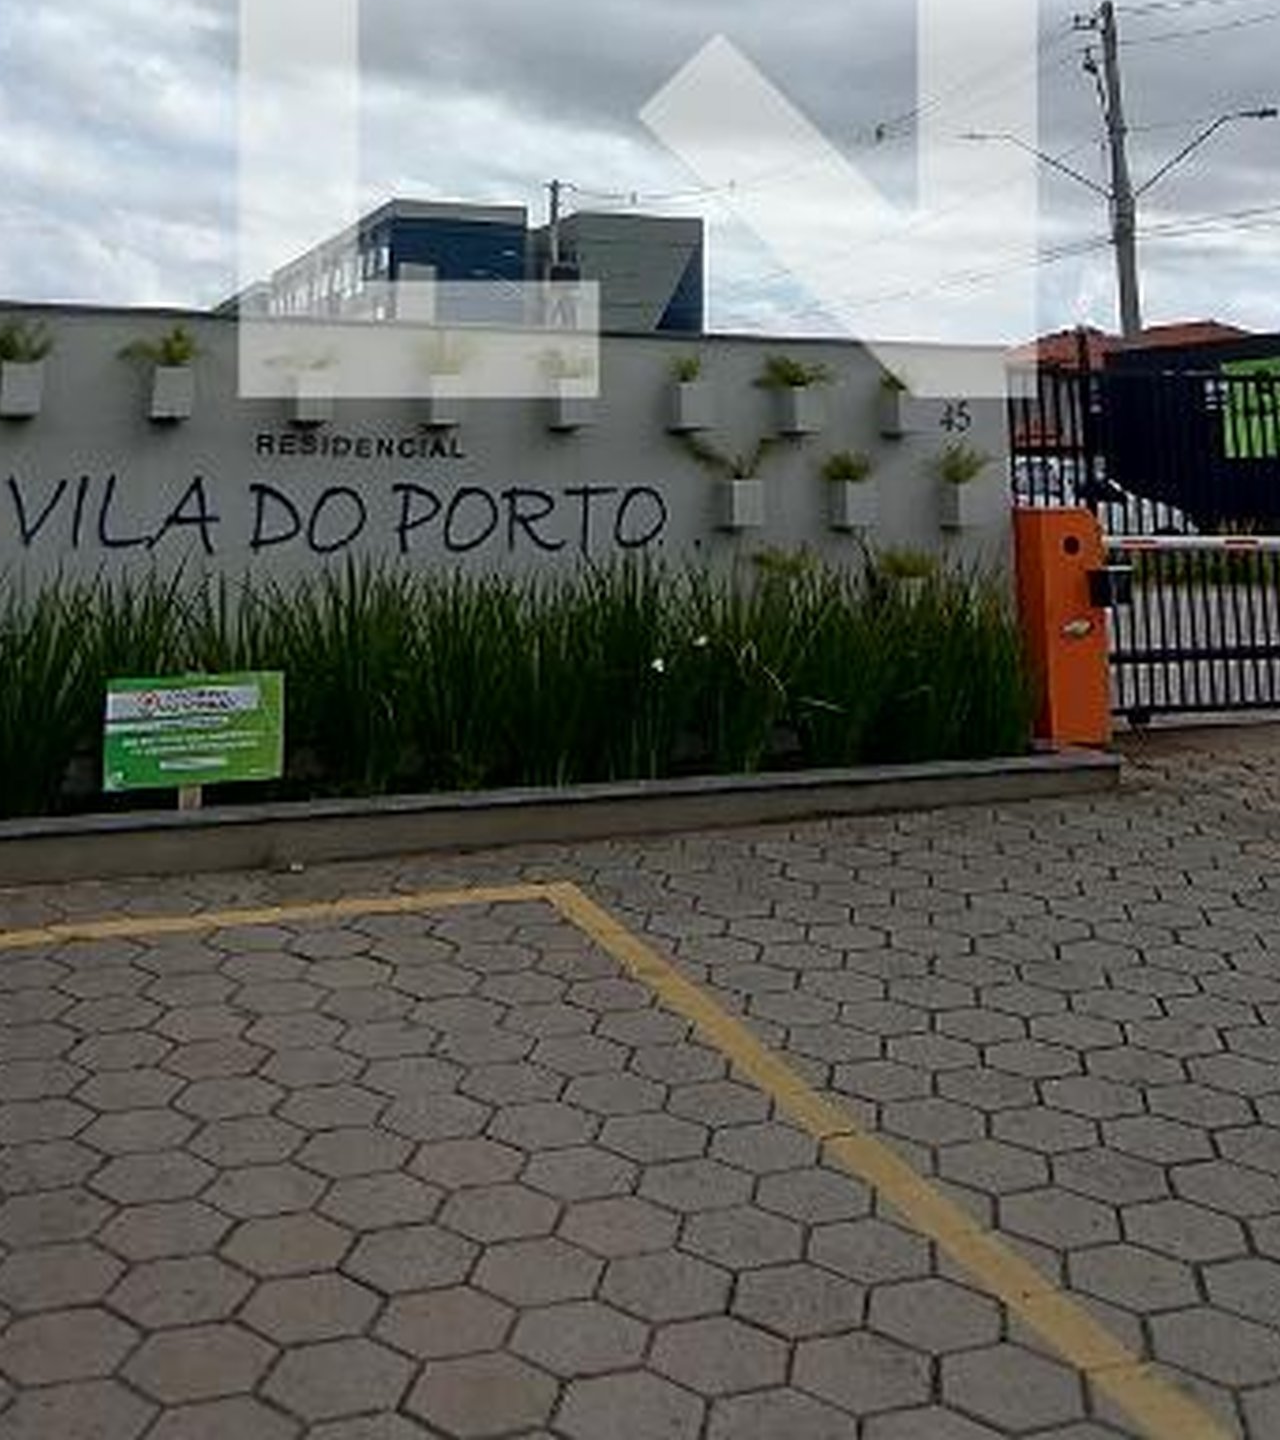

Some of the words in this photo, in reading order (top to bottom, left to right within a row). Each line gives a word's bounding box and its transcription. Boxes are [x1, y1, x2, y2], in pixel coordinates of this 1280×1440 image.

[255, 432, 467, 459] RESIDENCIAL
[8, 474, 220, 554] VILA
[249, 483, 368, 553] DO
[392, 484, 669, 554] PORTO
